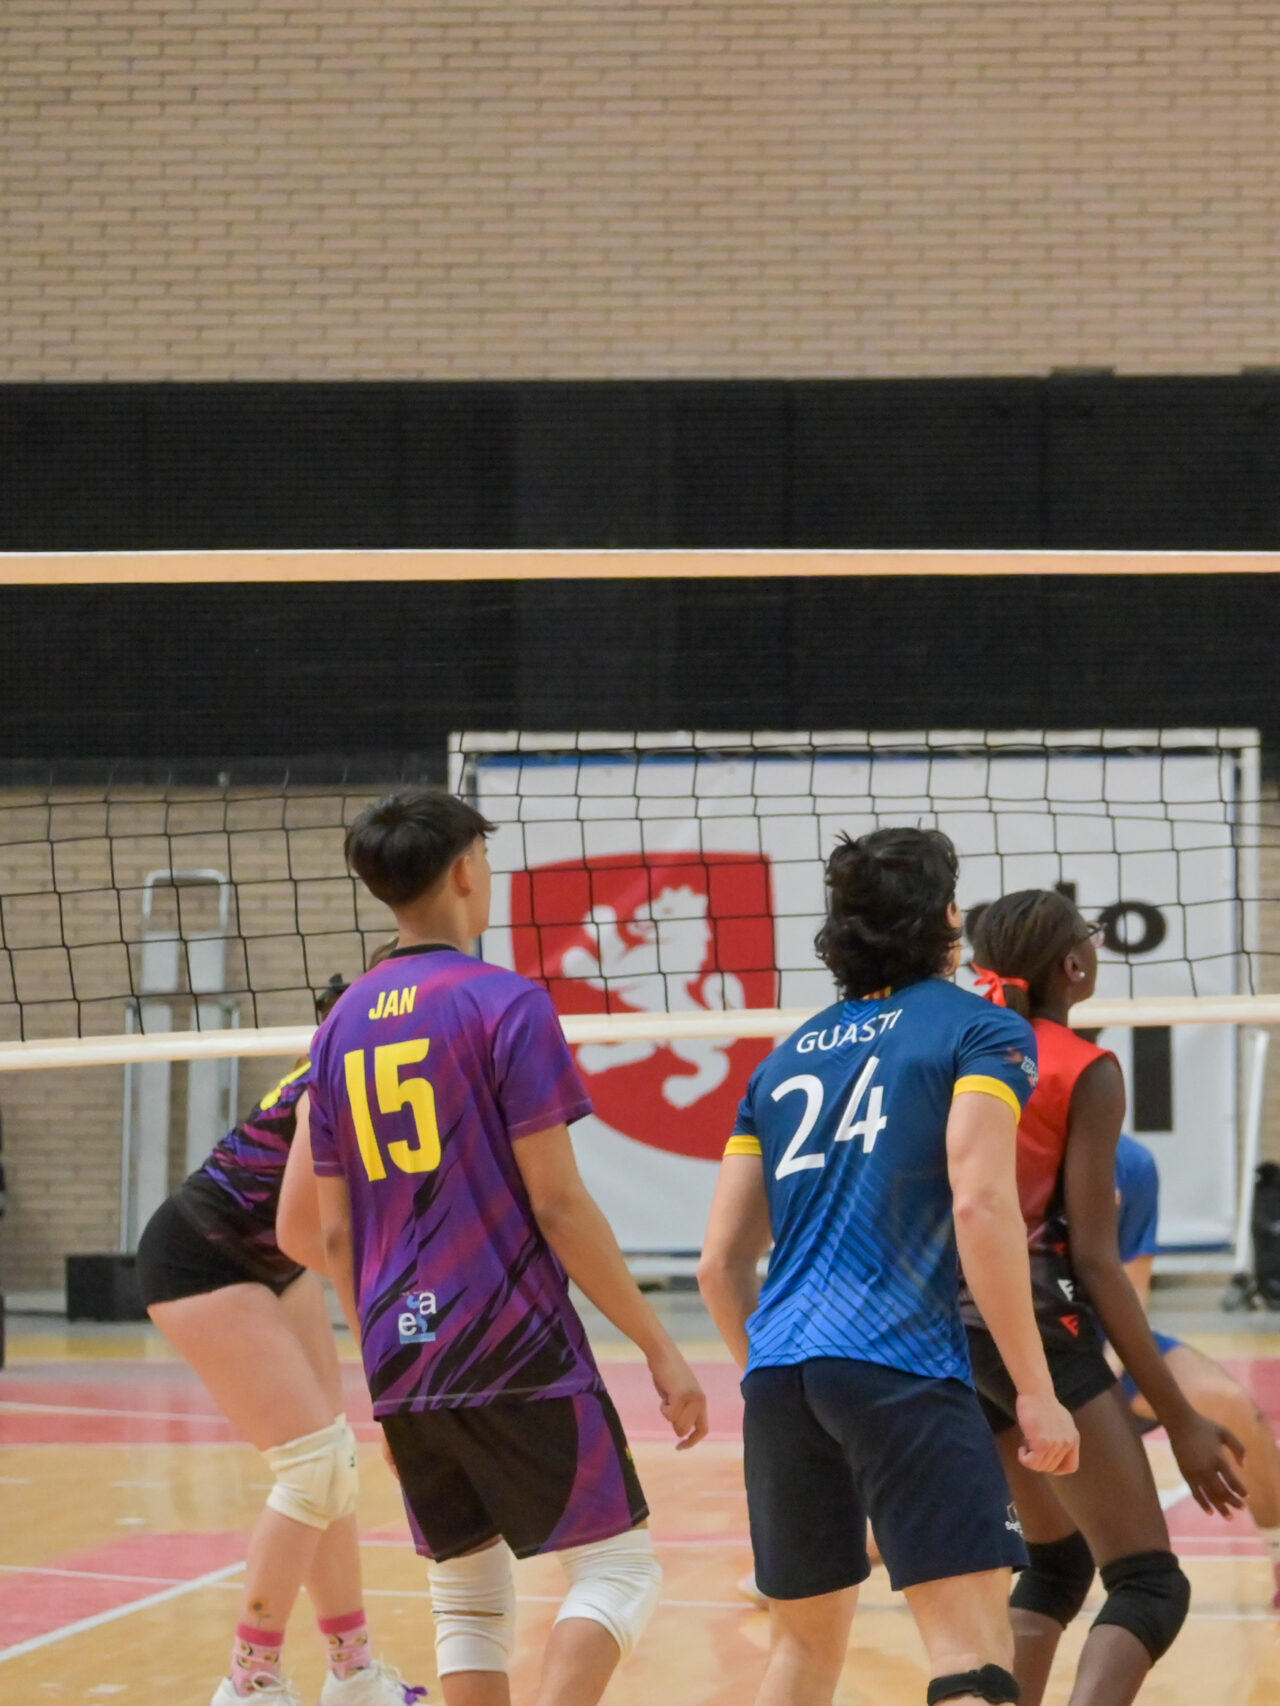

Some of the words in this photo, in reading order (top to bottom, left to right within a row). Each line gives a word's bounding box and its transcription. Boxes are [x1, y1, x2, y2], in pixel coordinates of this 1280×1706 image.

[368, 985, 417, 1020] JAN
[796, 1008, 903, 1054] GUASTI
[344, 1038, 441, 1182] 15
[771, 1055, 888, 1182] 24
